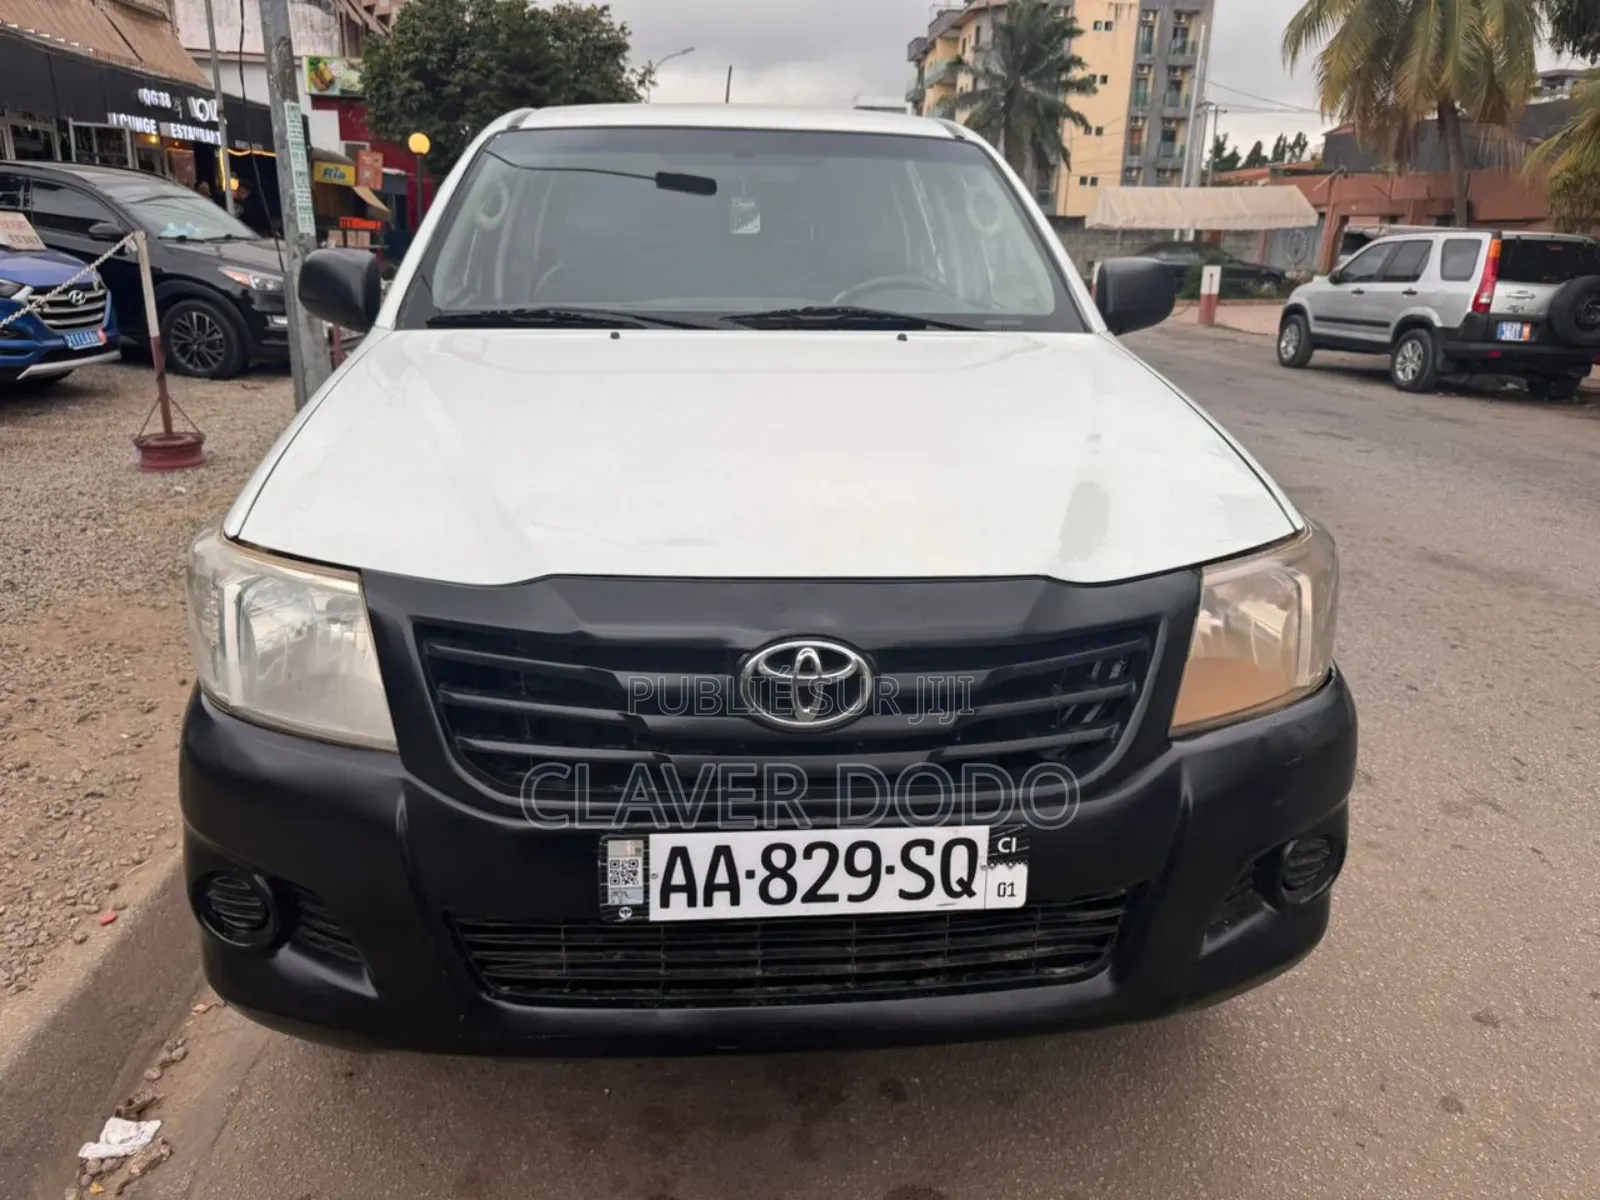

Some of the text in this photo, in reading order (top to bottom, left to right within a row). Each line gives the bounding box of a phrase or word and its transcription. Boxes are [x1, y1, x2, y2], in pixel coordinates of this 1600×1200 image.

[160, 121, 221, 145] ESTAURANT
[997, 837, 1017, 853] CI
[997, 881, 1016, 898] 01
